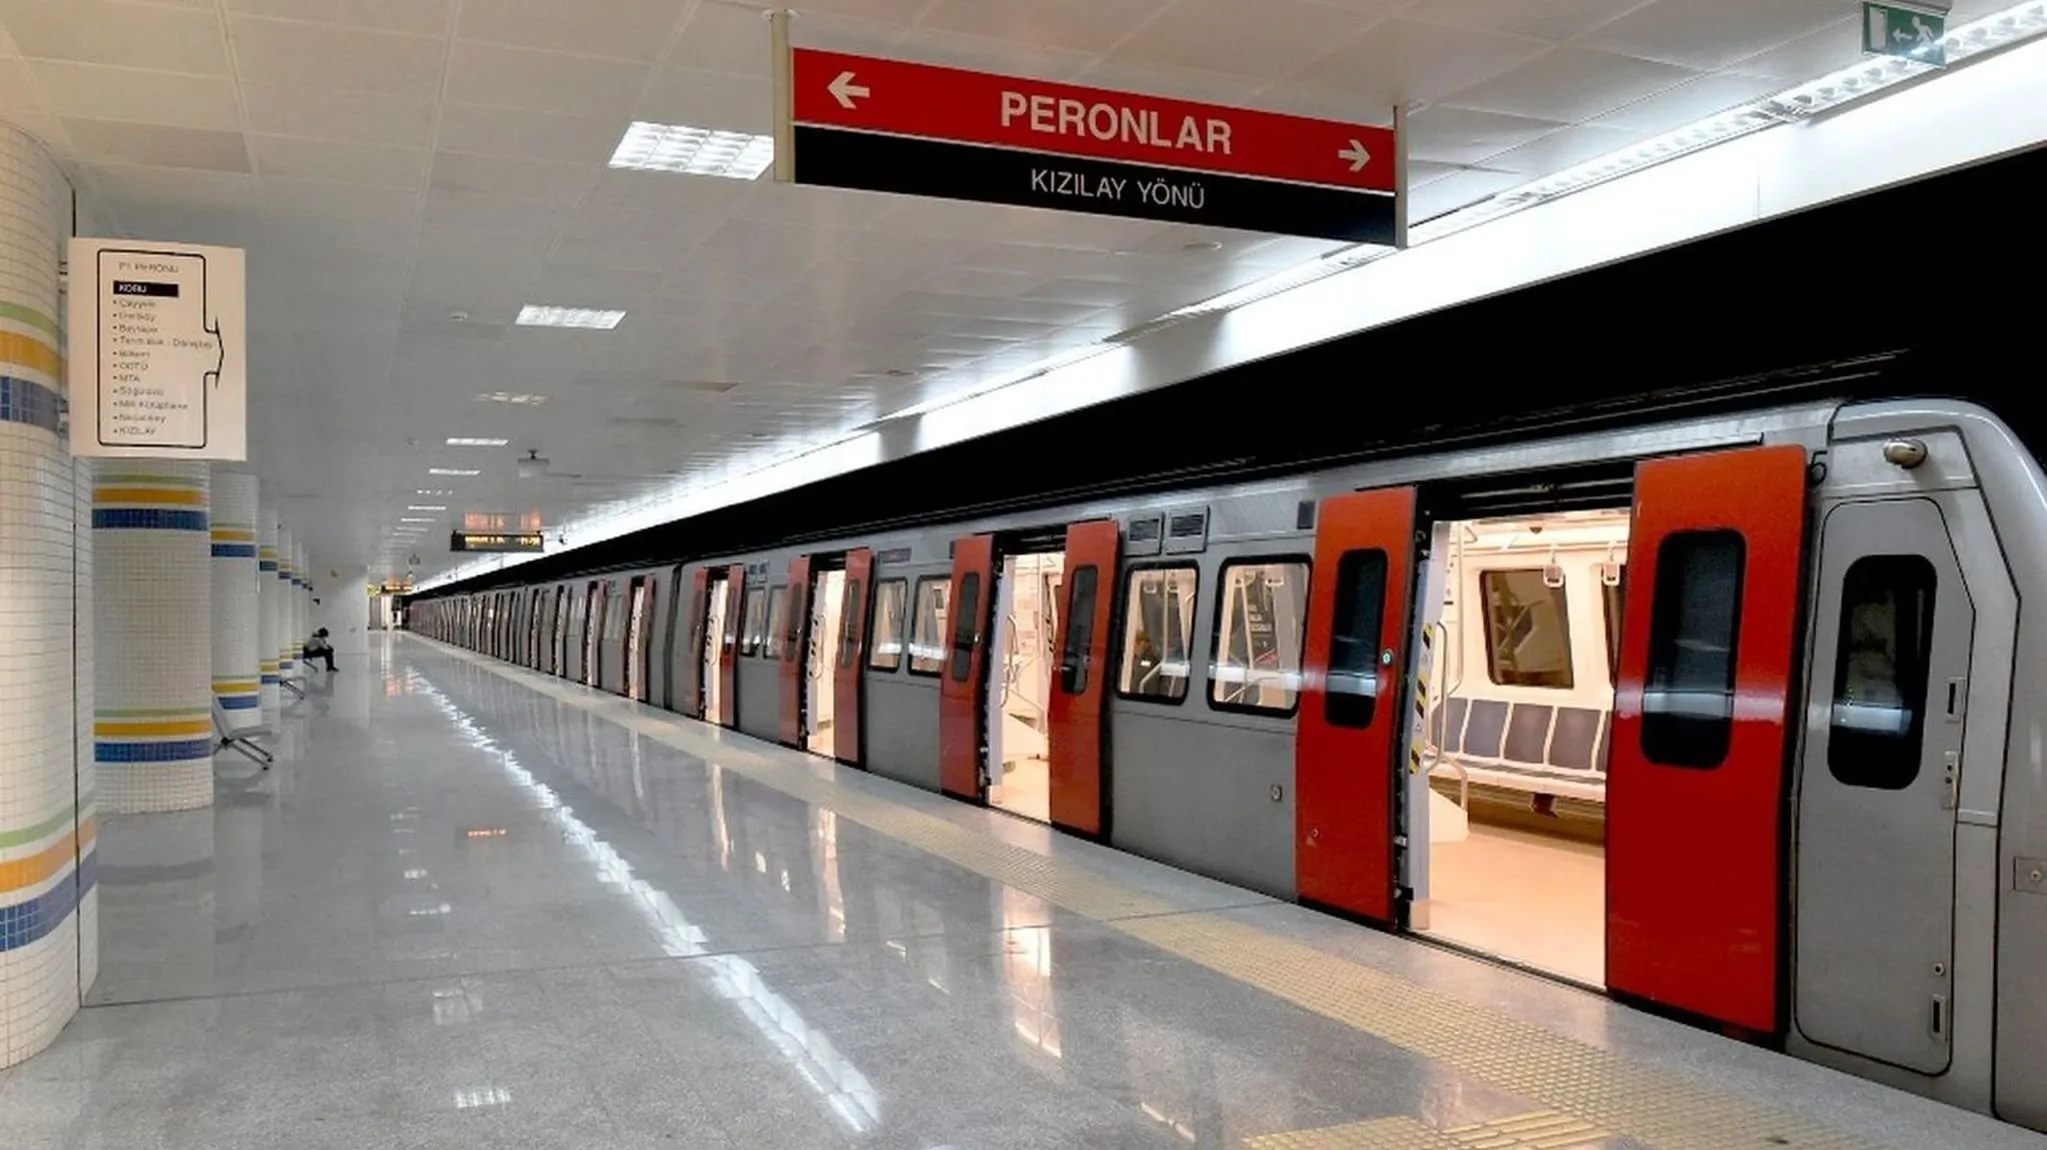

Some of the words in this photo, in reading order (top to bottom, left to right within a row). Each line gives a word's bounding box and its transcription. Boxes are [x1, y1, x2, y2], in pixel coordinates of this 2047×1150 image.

[1001, 91, 1232, 155] PERONLAR
[1031, 168, 1127, 200] KIZILAY
[1136, 177, 1206, 209] YÖNÜ
